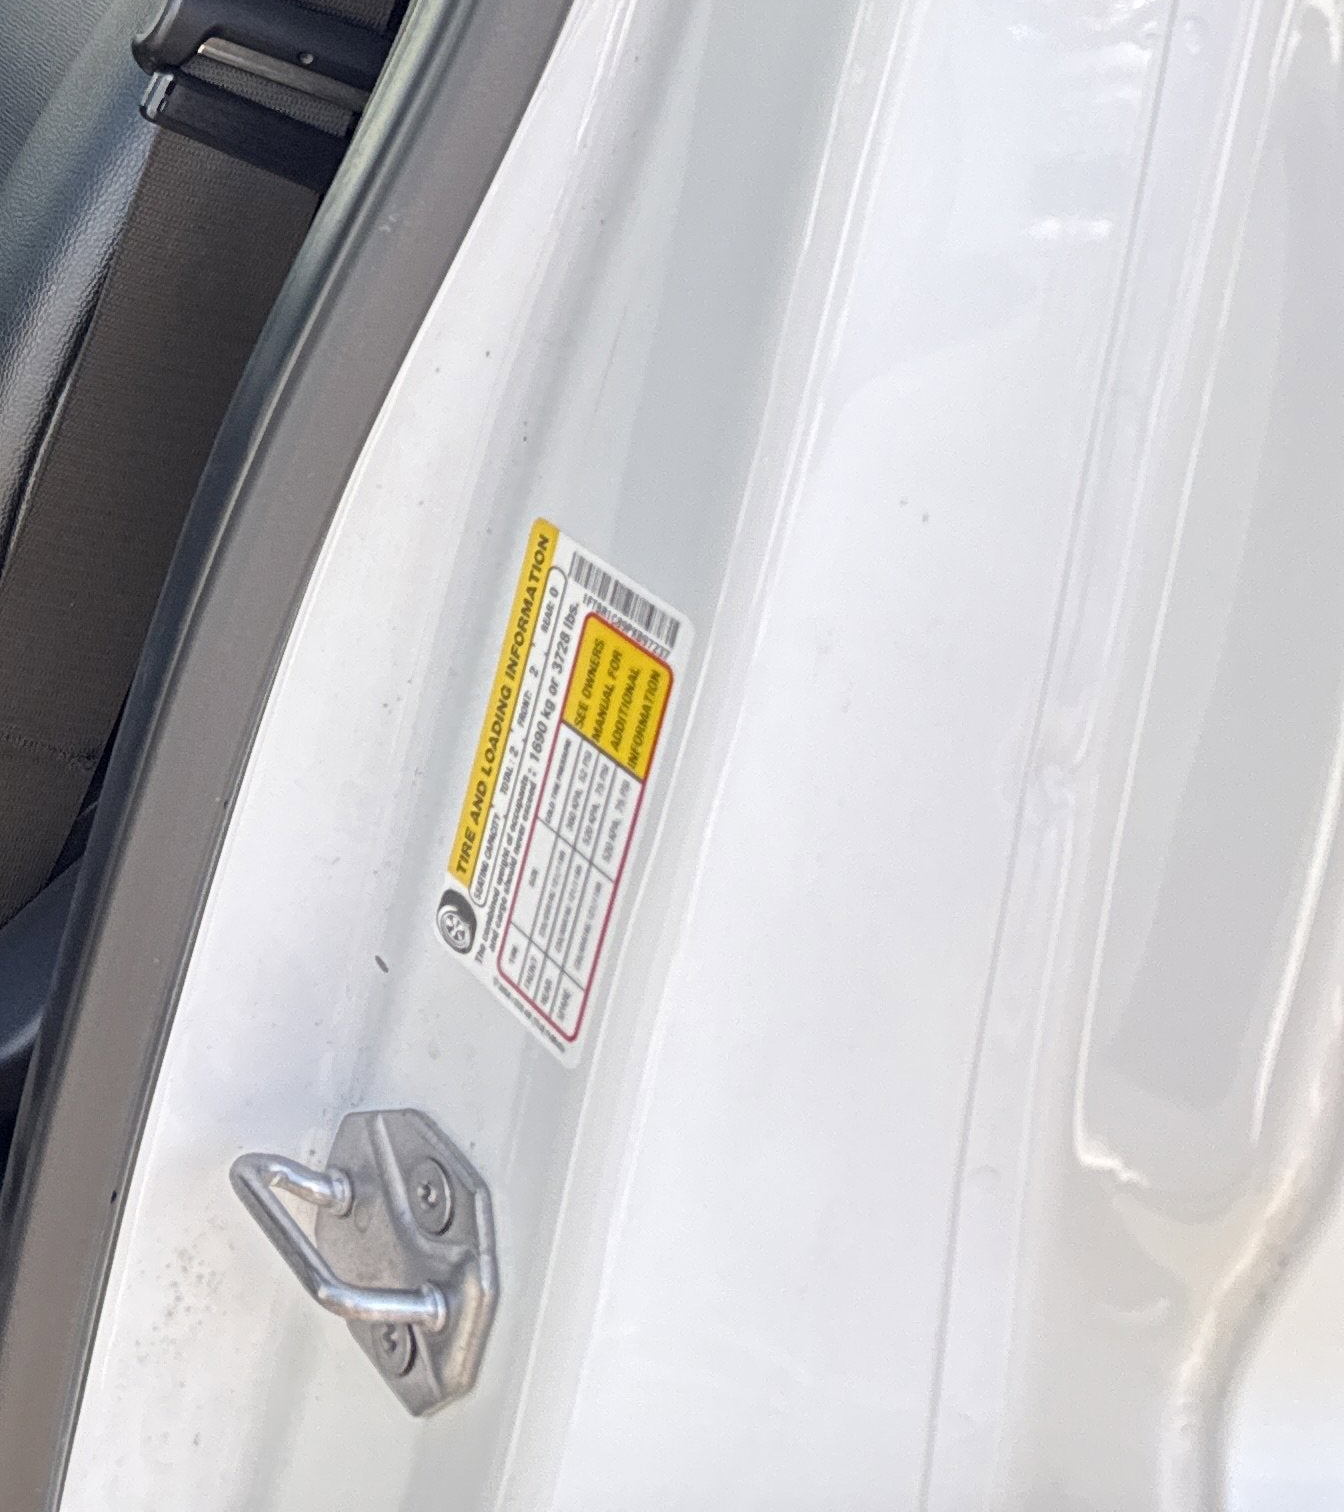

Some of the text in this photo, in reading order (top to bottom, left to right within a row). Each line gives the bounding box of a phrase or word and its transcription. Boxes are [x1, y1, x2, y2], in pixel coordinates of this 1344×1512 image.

[552, 631, 571, 674] 3728
[563, 603, 579, 630] lbs.
[456, 534, 549, 875] TIRE AND LOADING INFORMATION
[541, 699, 556, 720] kg
[548, 677, 559, 697] or
[575, 638, 605, 729] SEE OWNERS
[592, 648, 622, 743] MANUAL FOR
[610, 667, 641, 752] ADDITIONAL
[628, 669, 661, 769] INFORMATION
[474, 860, 489, 900] SEATING
[484, 811, 501, 860] CAPACITY
[509, 746, 519, 758] 2
[529, 665, 539, 678] 2
[549, 587, 559, 599] 0
[530, 721, 548, 762] 1690
